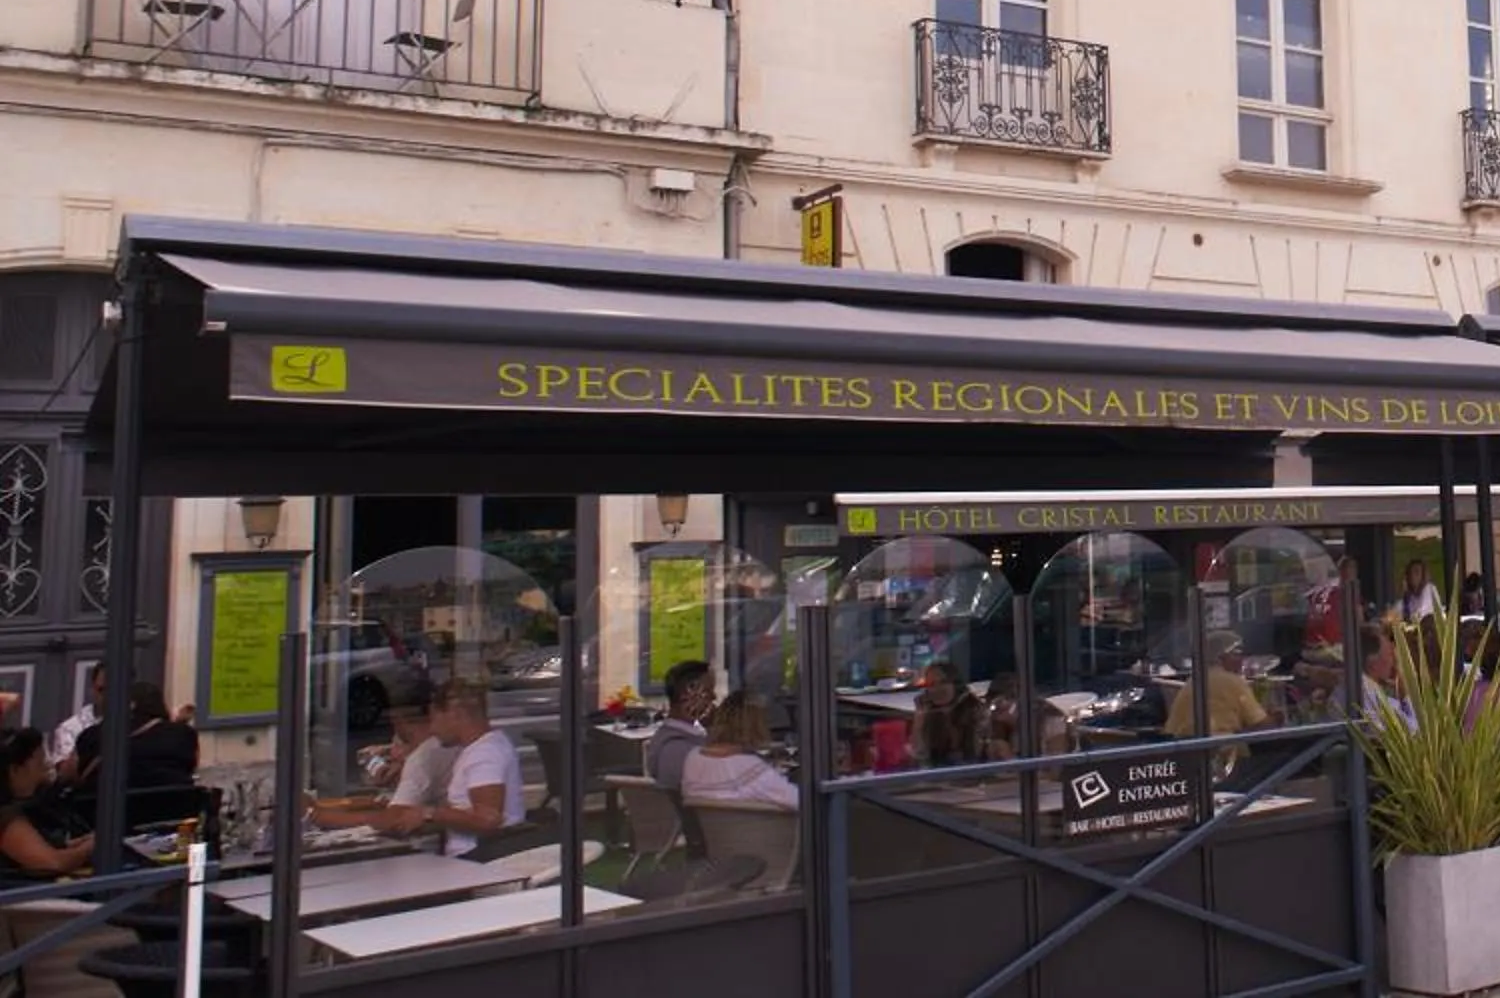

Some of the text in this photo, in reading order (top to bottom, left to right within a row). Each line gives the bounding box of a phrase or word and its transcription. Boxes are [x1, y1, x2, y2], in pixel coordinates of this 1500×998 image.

[498, 363, 872, 409] SPECIALITES
[894, 379, 1199, 419] REGIONALES
[1214, 393, 1258, 420] ET
[1273, 395, 1371, 423] VINS
[1382, 398, 1431, 424] DE
[899, 502, 1324, 531] HÔTEL CRISTAL RESTAURANT
[1129, 759, 1177, 781] ENTRÉE
[1118, 780, 1188, 803] ENTRANCE
[1070, 805, 1190, 835] BAR HOTEL RESTAURANT
